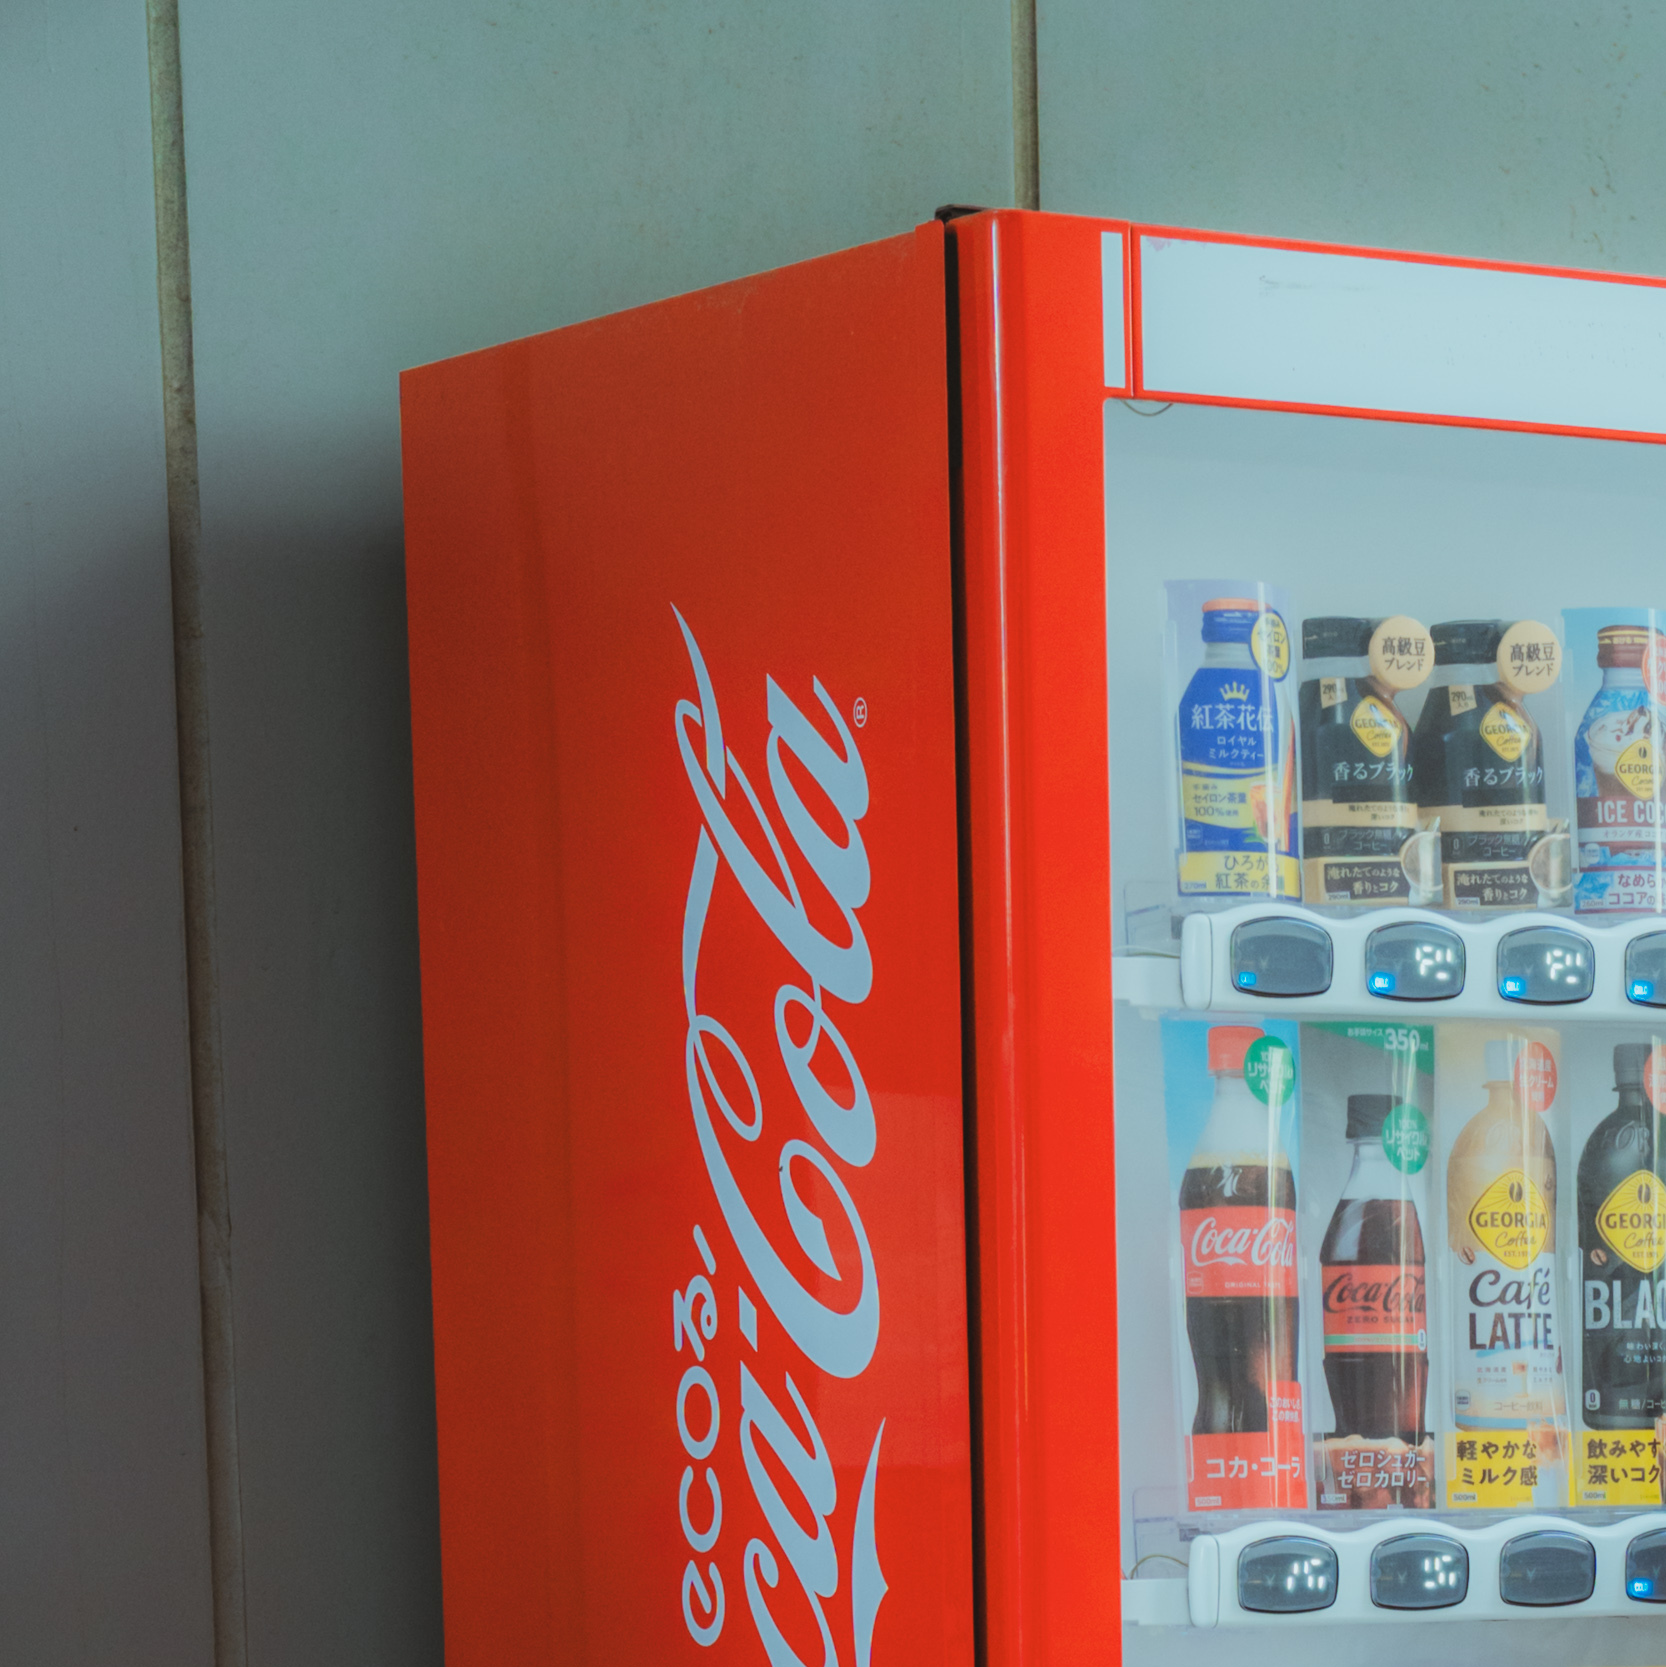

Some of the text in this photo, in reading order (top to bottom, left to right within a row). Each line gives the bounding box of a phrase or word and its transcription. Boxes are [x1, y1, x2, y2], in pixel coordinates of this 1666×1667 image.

[1382, 637, 1426, 656] 高級豆
[1510, 643, 1556, 662] 高級豆
[1384, 658, 1425, 671] ブレンド
[1513, 664, 1555, 677] ブレンド
[1191, 703, 1275, 733] 紅茶花伝
[1216, 735, 1257, 746] ロイヤル
[1208, 747, 1265, 760] ミルクティー
[1334, 762, 1413, 782] 香るブラック
[1464, 766, 1543, 787] 香るブラック
[1192, 792, 1247, 804] セイロン茶葉
[1597, 801, 1627, 824] ICE
[1352, 881, 1399, 895] 香りとコク
[1482, 888, 1528, 902] 香りとコク
[1476, 1211, 1547, 1229] GEORGIA
[1191, 1217, 1294, 1268] Coca-Cola
[1495, 1231, 1537, 1249] Coffee
[1624, 1232, 1664, 1250] Coffee
[1324, 1273, 1425, 1314] Coca-Cola
[1469, 1268, 1551, 1310] Café
[1469, 1313, 1554, 1350] LATTE
[1457, 1440, 1537, 1461] 軽やかな
[1206, 1456, 1300, 1479] コカ・コーラ
[1341, 1451, 1426, 1470] ゼロシュガー
[1461, 1466, 1538, 1487] ミルク感
[1587, 1465, 1661, 1486] 深いコク
